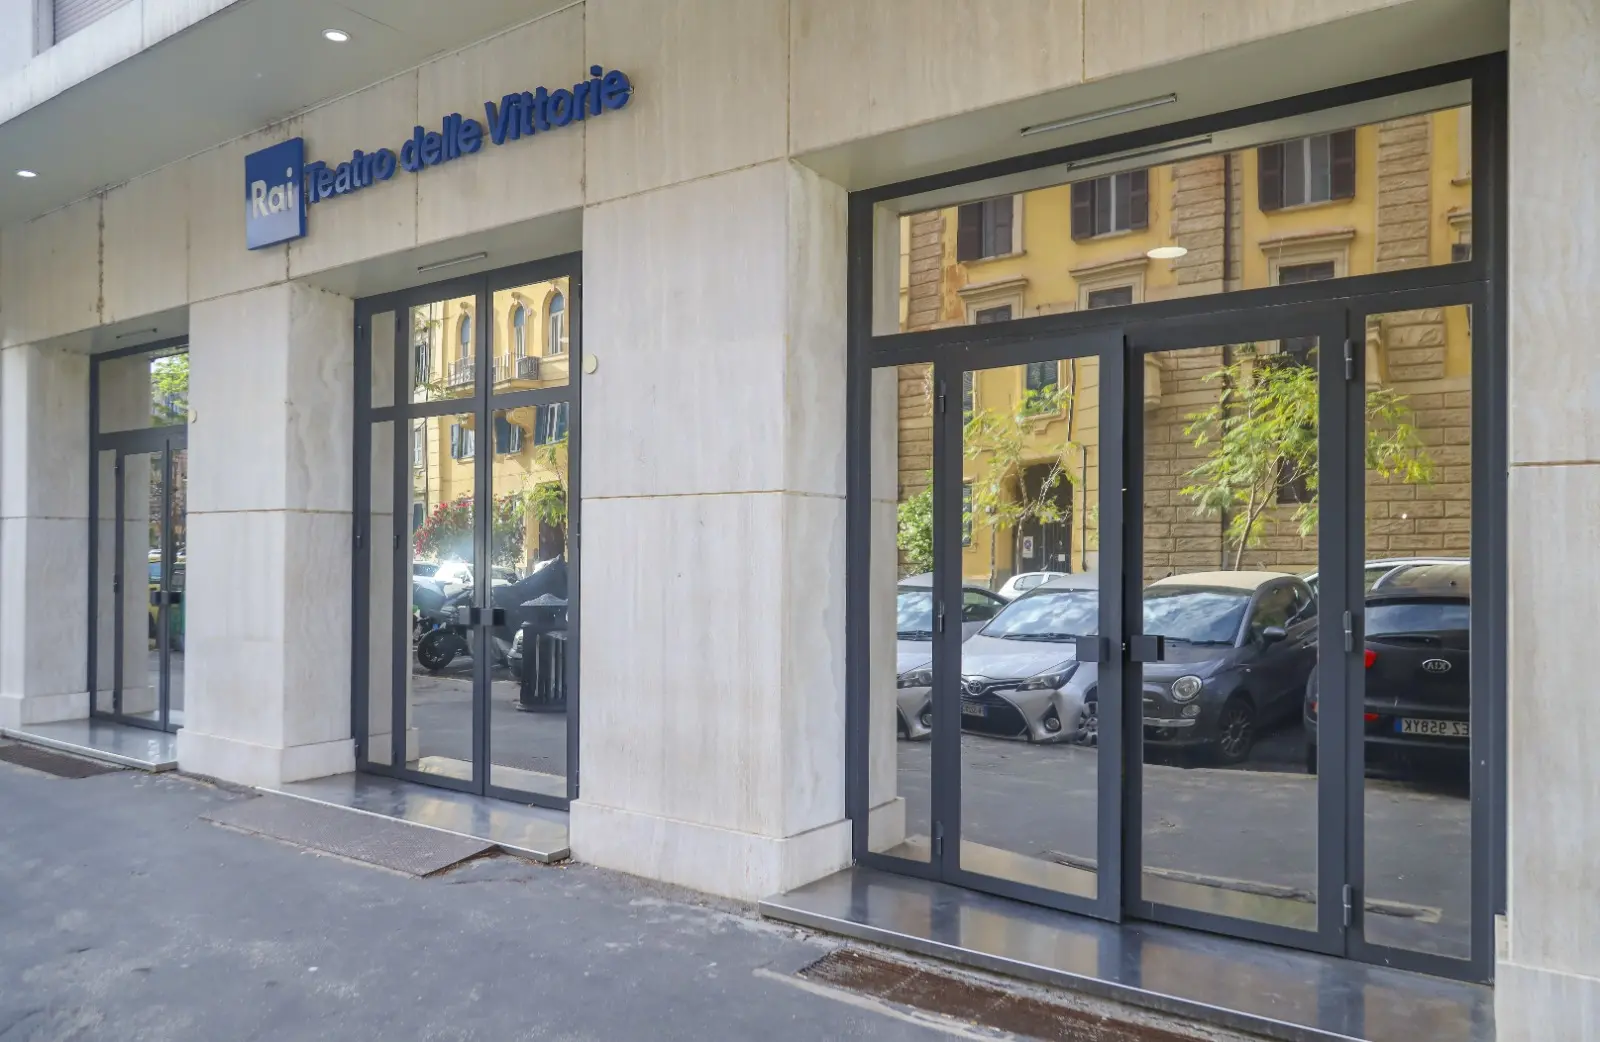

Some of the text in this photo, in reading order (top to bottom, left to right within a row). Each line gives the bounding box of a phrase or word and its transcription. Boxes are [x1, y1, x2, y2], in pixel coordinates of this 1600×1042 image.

[305, 64, 632, 204] Teatro delle Vittorie
[251, 167, 293, 219] Rai
